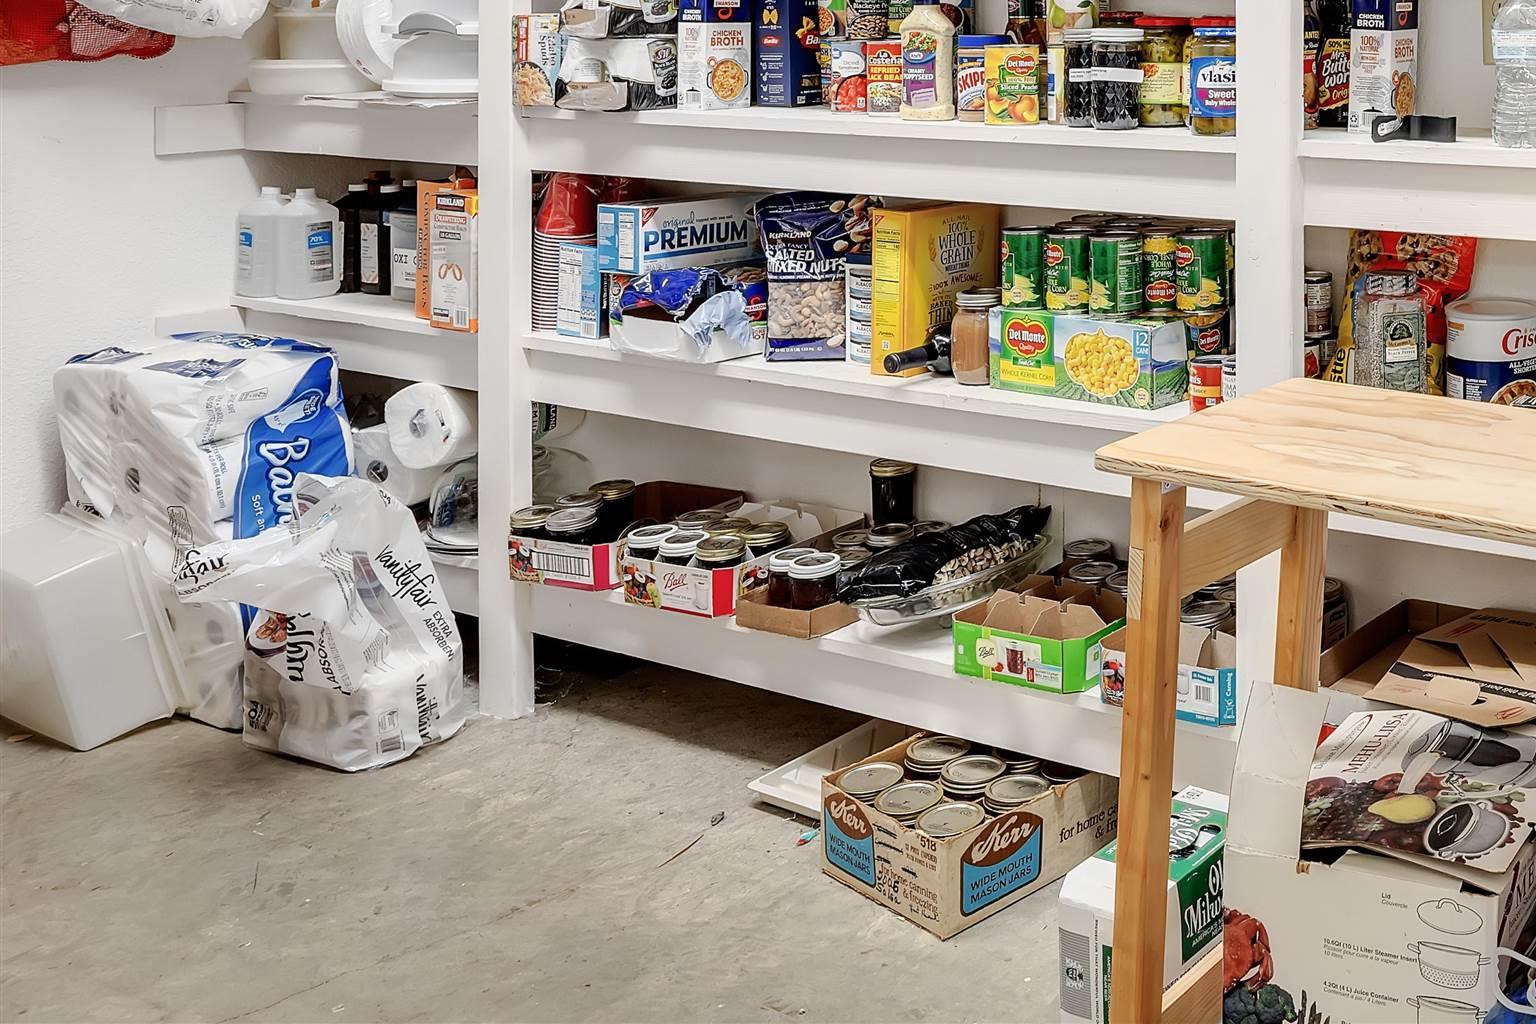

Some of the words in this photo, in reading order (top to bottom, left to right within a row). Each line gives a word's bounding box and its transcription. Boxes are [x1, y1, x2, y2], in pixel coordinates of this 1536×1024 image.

[1357, 19, 1384, 28] BROTH
[711, 37, 744, 46] BROTH
[1328, 40, 1343, 48] 50%
[1360, 36, 1380, 46] 100%
[1396, 39, 1413, 47] CHICKEN
[1395, 46, 1414, 58] BROTH
[958, 71, 984, 92] SKIPP
[1201, 70, 1236, 83] vlasi
[1208, 90, 1236, 98] Sweet
[663, 211, 694, 229] original
[948, 222, 968, 233] 100%
[644, 220, 748, 252] PREMIUM
[769, 231, 812, 239] KIRKLAND
[939, 230, 976, 249] WHOLE
[394, 254, 408, 264] OXI
[941, 246, 974, 265] GRAIN
[810, 257, 847, 273] NUTS
[933, 280, 949, 291] 100%
[951, 273, 979, 286] AWESOME
[1052, 285, 1067, 293] CORN
[1009, 328, 1021, 340] Del
[1022, 330, 1045, 344] Monte
[1135, 332, 1149, 346] 12
[1001, 368, 1019, 376] WHOLE
[1020, 371, 1038, 379] KERNEL
[1039, 373, 1054, 382] CORN
[252, 494, 262, 519] Soft
[664, 572, 689, 592] Ball
[433, 611, 452, 638] EXTRA
[978, 645, 995, 659] Ball
[1341, 712, 1408, 774] MEHU-LIISA
[830, 799, 867, 833] Kerr
[1059, 826, 1075, 844] for
[1076, 814, 1106, 834] home
[1094, 828, 1106, 840] &
[920, 836, 937, 852] 518
[972, 814, 1033, 864] Kerr
[830, 832, 845, 850] WIDE
[846, 844, 871, 864] MOUTH
[830, 845, 854, 866] MASON
[853, 857, 871, 875] JARS
[970, 872, 997, 891] WIDE
[998, 852, 1033, 876] MOUTH
[909, 877, 938, 904] canning
[970, 878, 1007, 904] MASON
[1008, 865, 1032, 884] JARS
[909, 889, 938, 913] freezing
[1381, 892, 1392, 900] Lid
[1381, 899, 1409, 909] Couvercle
[1342, 942, 1352, 951] (10
[1353, 944, 1359, 952] L)
[1360, 945, 1374, 955] Liter
[1374, 948, 1400, 961] Steamer
[1400, 953, 1418, 963] Insert
[1323, 980, 1339, 989] 4.2Qt
[1339, 984, 1346, 992] (4
[1353, 987, 1369, 997] Juice
[1370, 991, 1399, 1003] Container
